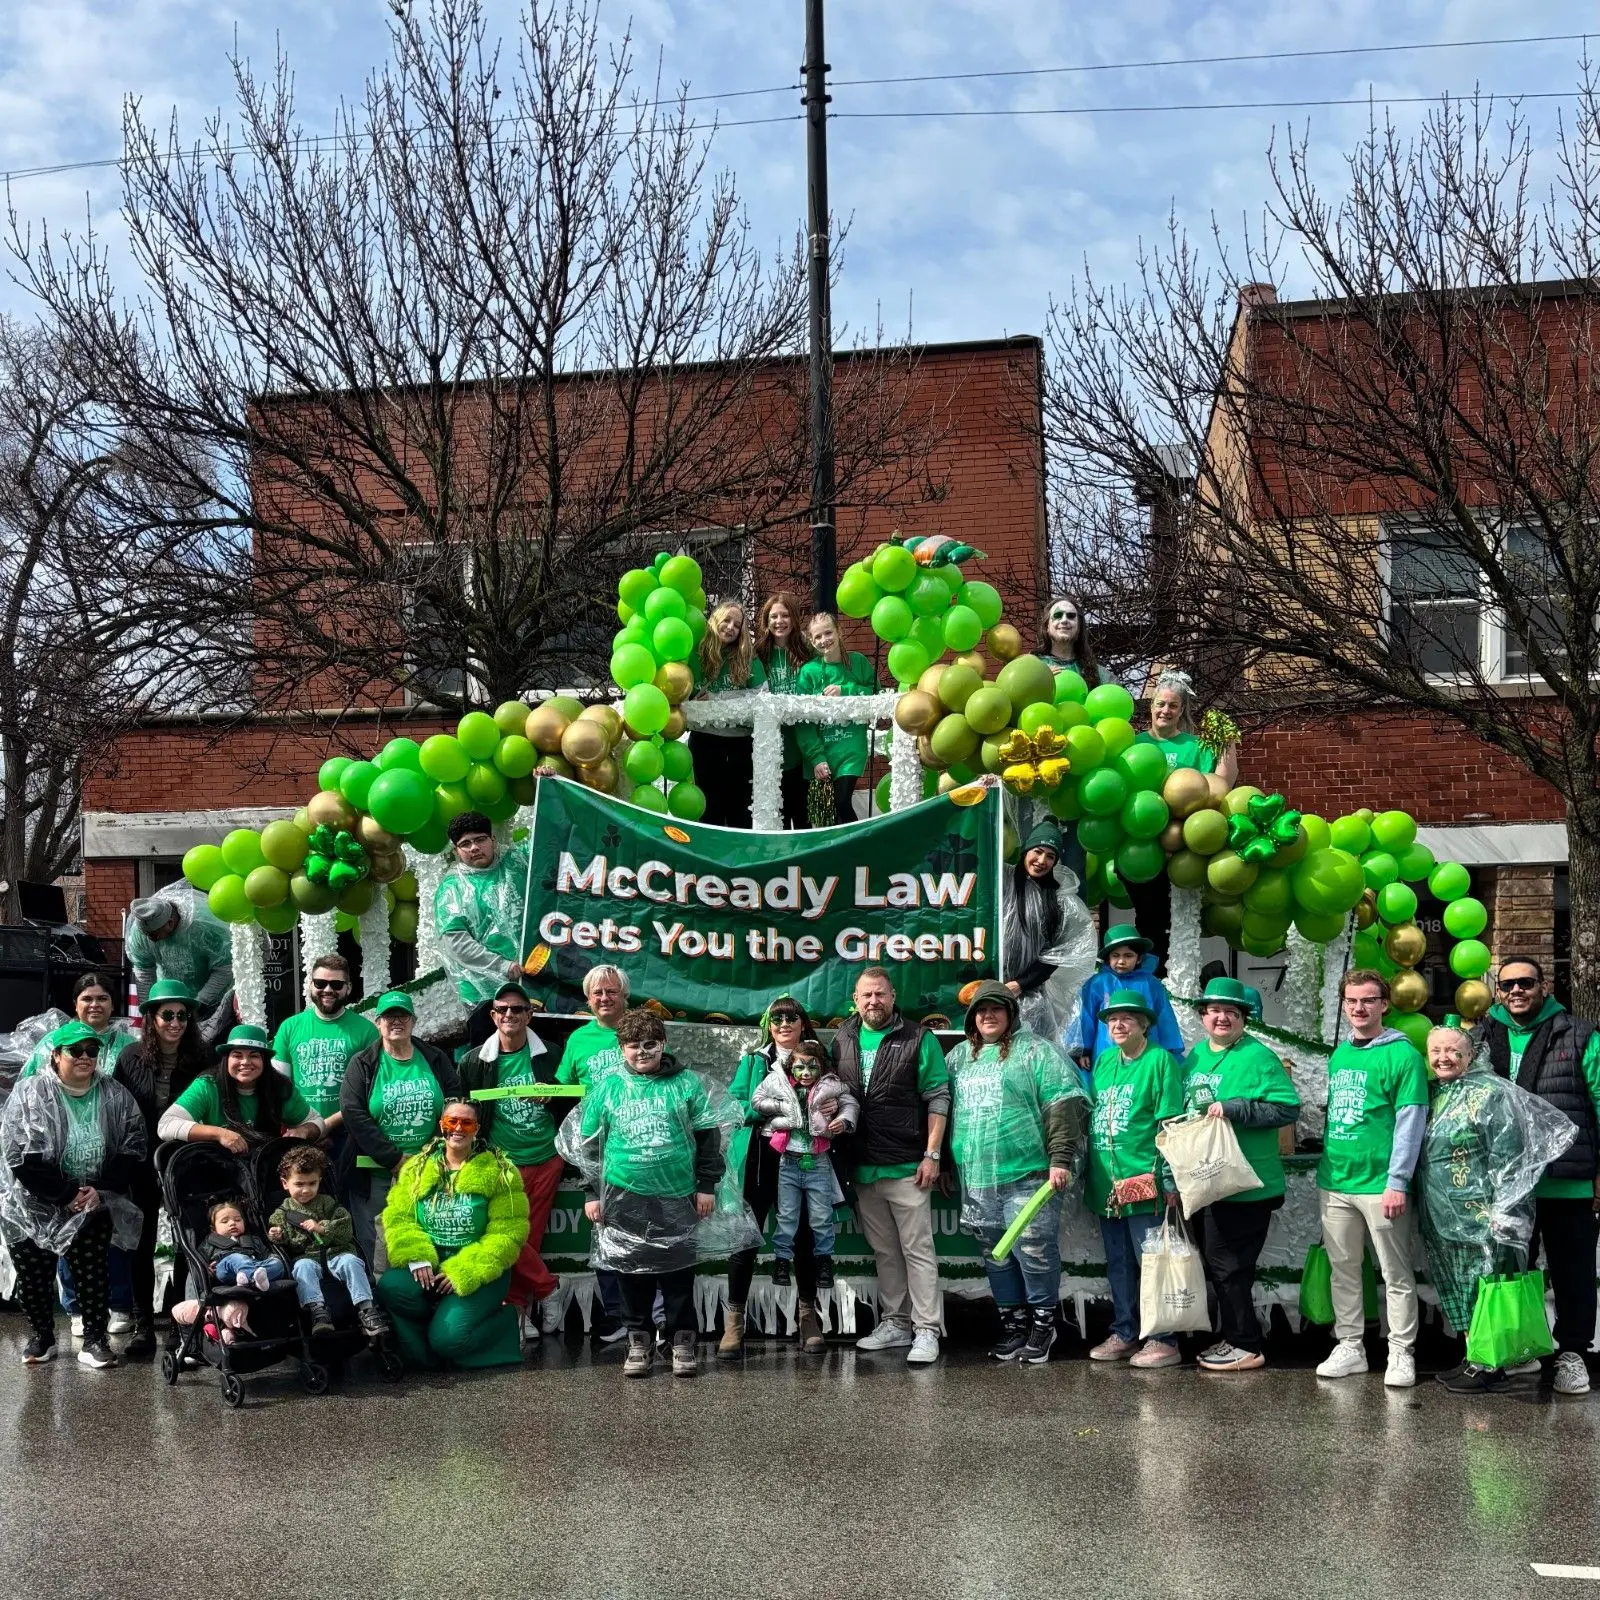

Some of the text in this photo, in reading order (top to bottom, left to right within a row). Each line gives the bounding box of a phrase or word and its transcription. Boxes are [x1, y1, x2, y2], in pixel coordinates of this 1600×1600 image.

[556, 851, 976, 919] McCready Law
[539, 911, 986, 963] Gets You the Green!
[306, 1062, 345, 1075] JUSTICE
[392, 1100, 434, 1114] JUSTICE
[630, 1121, 670, 1139] JUSTICE
[73, 1146, 105, 1162] JUSTIC
[434, 1217, 473, 1229] JUSTICE
